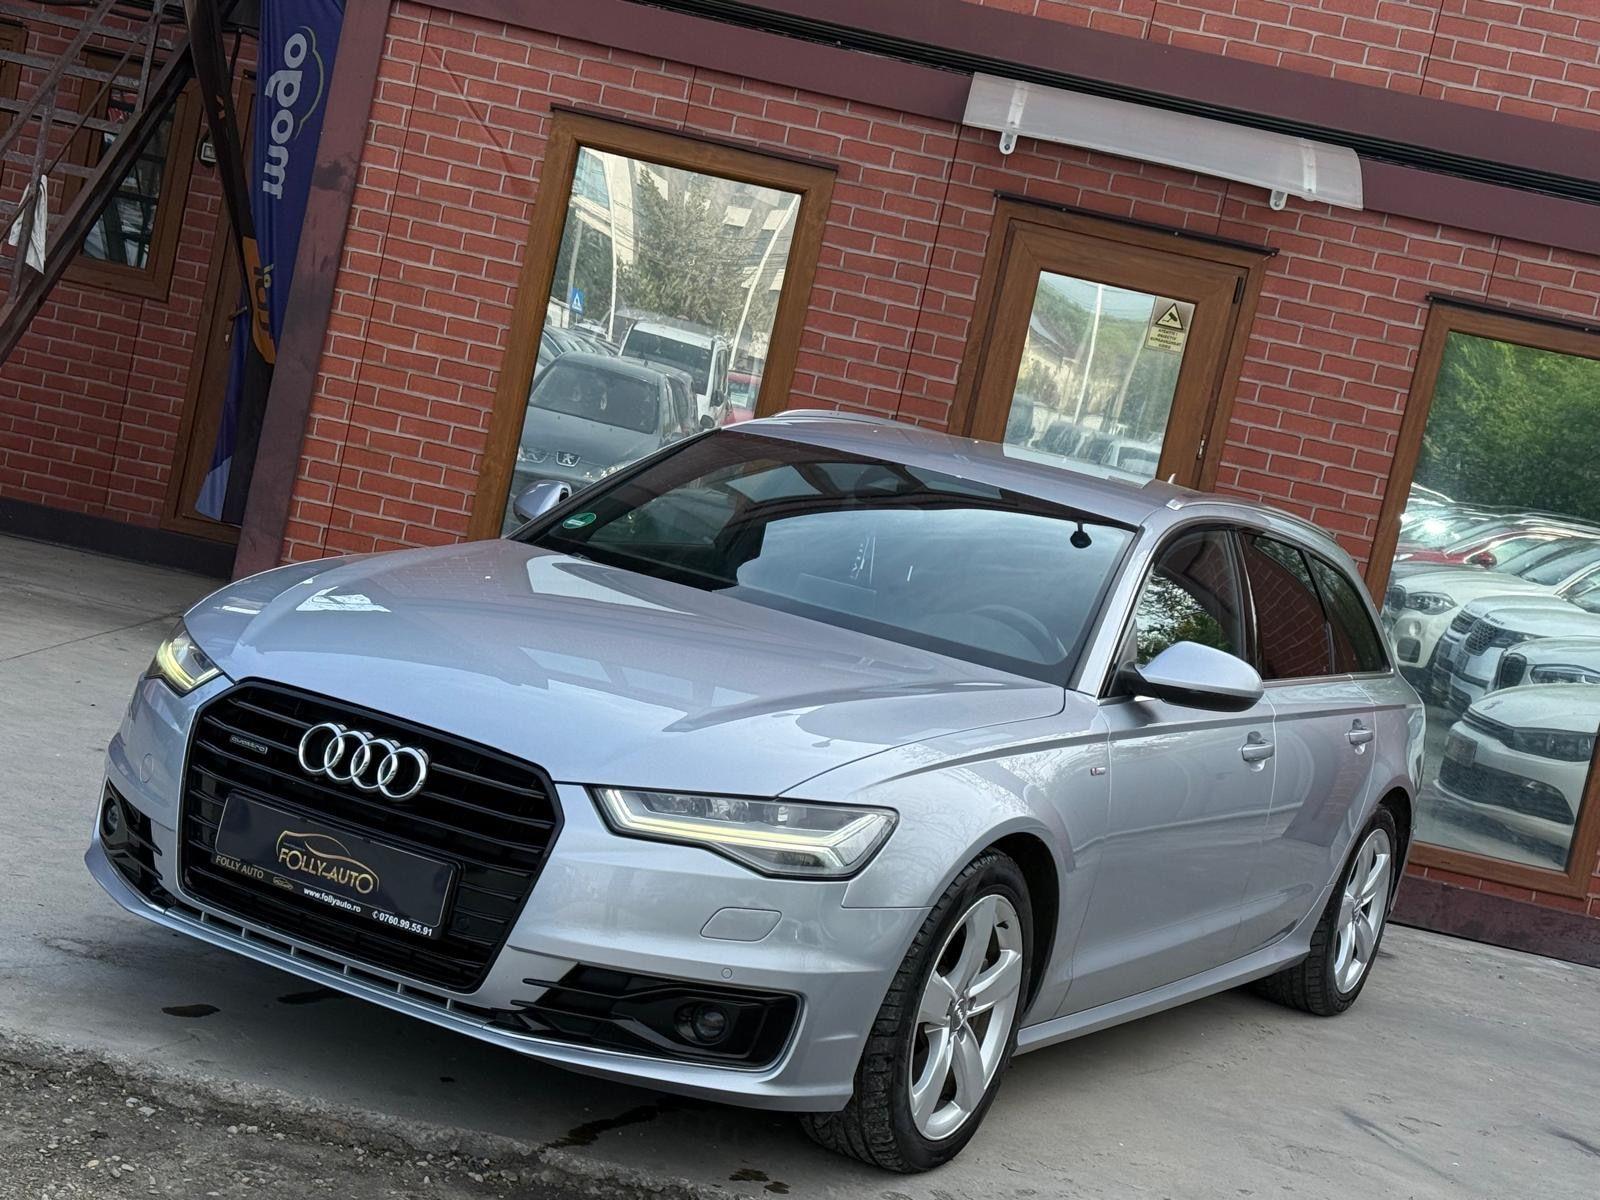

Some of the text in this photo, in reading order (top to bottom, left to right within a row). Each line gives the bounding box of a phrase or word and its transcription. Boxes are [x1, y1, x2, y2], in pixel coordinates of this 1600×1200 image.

[216, 856, 264, 880] FOLLY AUTO
[304, 888, 361, 912] www.follyauto.ro
